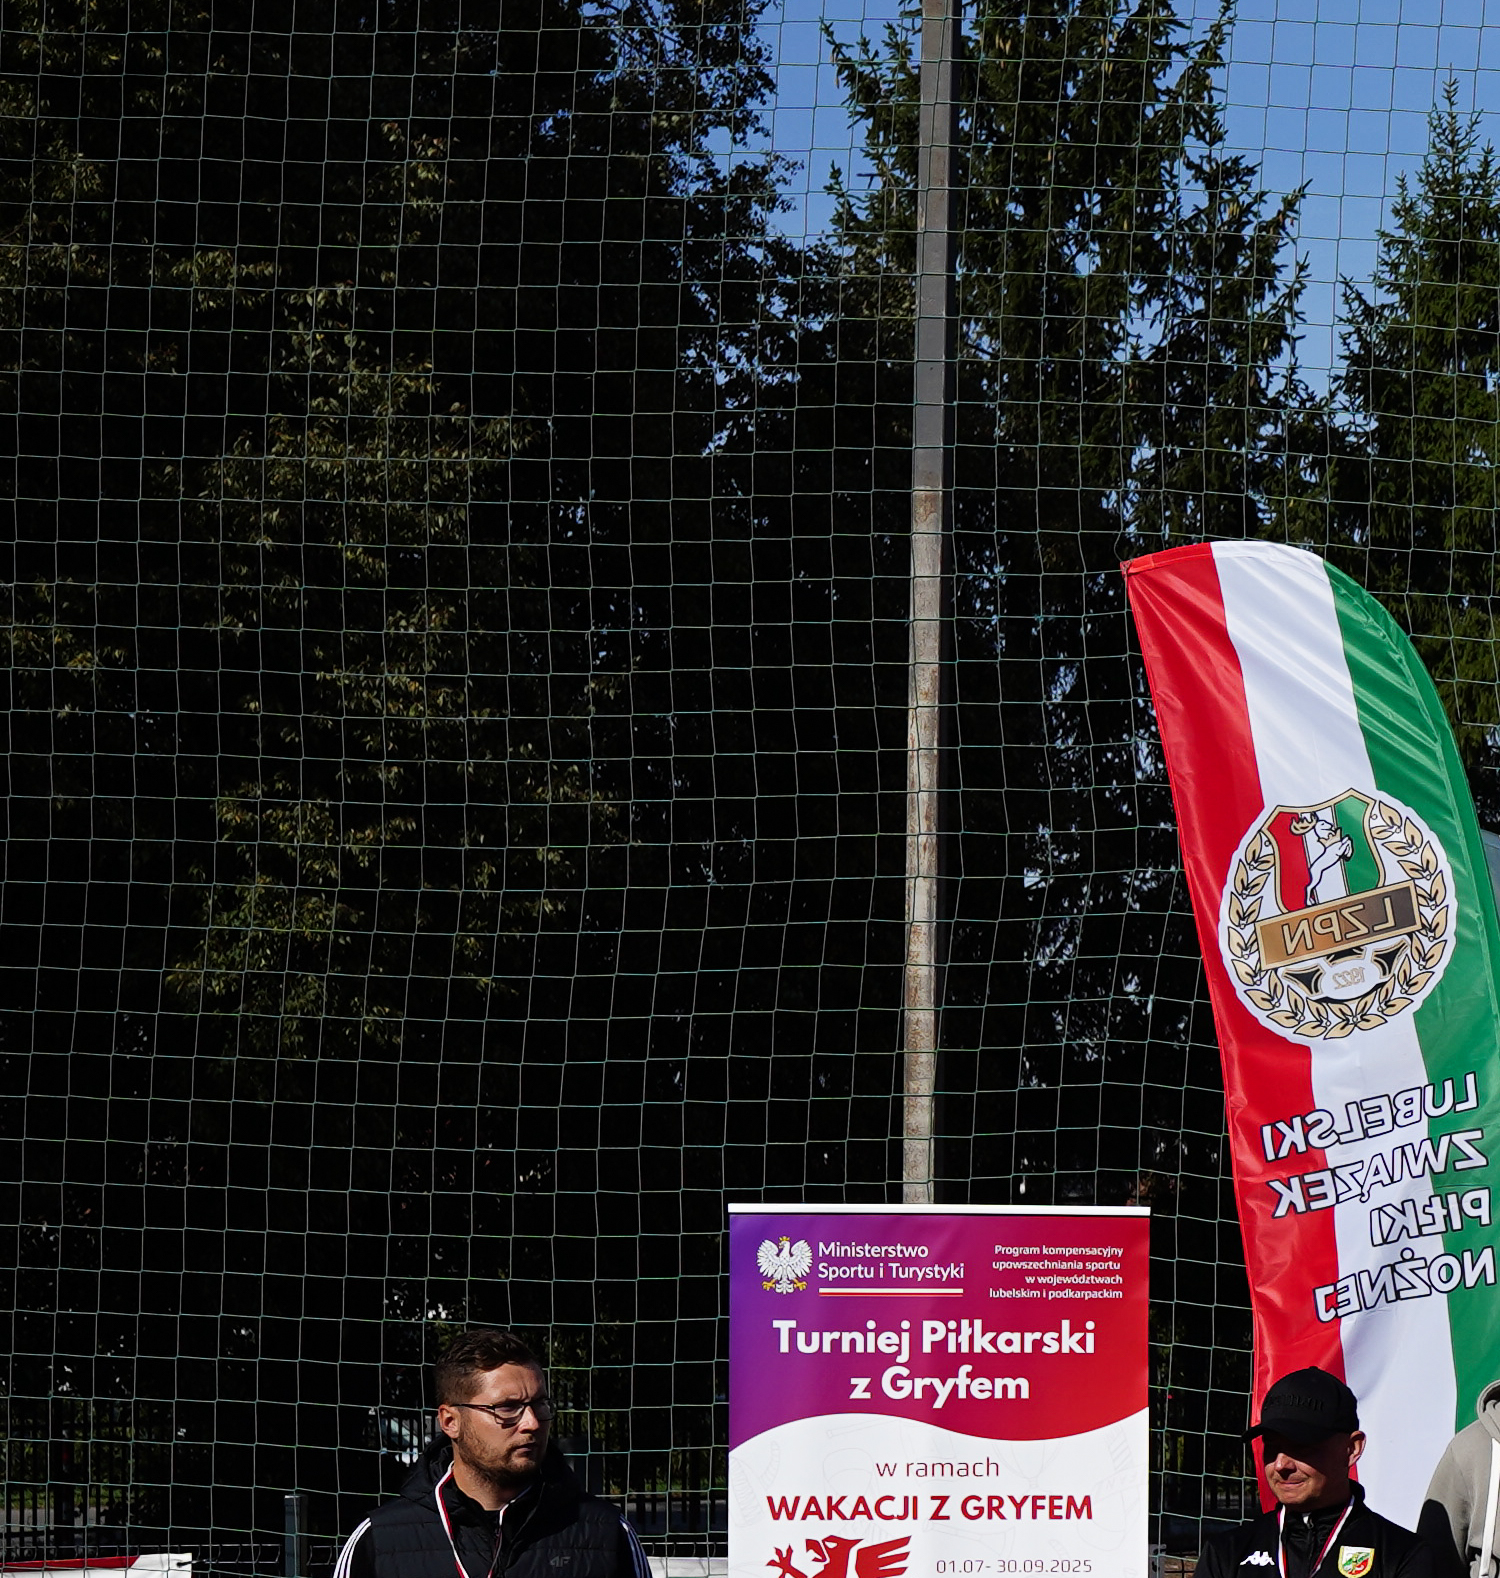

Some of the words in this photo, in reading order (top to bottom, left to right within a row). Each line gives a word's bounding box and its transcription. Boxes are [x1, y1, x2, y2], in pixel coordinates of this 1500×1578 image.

[818, 1242, 929, 1258] Ministerstwo
[995, 1245, 1039, 1257] Program
[1042, 1245, 1124, 1257] kompensacyjny
[818, 1263, 874, 1281] Sportu
[879, 1263, 883, 1278] i
[888, 1263, 964, 1281] Turystyki
[993, 1260, 1083, 1272] upowszechniania
[1086, 1260, 1120, 1272] sportu
[1026, 1276, 1034, 1284] w
[1036, 1274, 1123, 1286] województwach
[990, 1288, 1040, 1299] lubelskim
[1043, 1288, 1046, 1298] i
[1049, 1288, 1123, 1301] podkarpackim
[773, 1320, 911, 1364] Turniej
[922, 1320, 1095, 1354] Piłkarski
[850, 1377, 871, 1399] z
[881, 1365, 1029, 1409] Gryfem
[877, 1462, 897, 1477] w
[905, 1458, 999, 1477] ramach
[767, 1496, 918, 1520] WAKACJI
[930, 1496, 950, 1520] Z
[960, 1496, 1093, 1520] GRYFEM
[997, 1559, 1093, 1574] 30.09.2025
